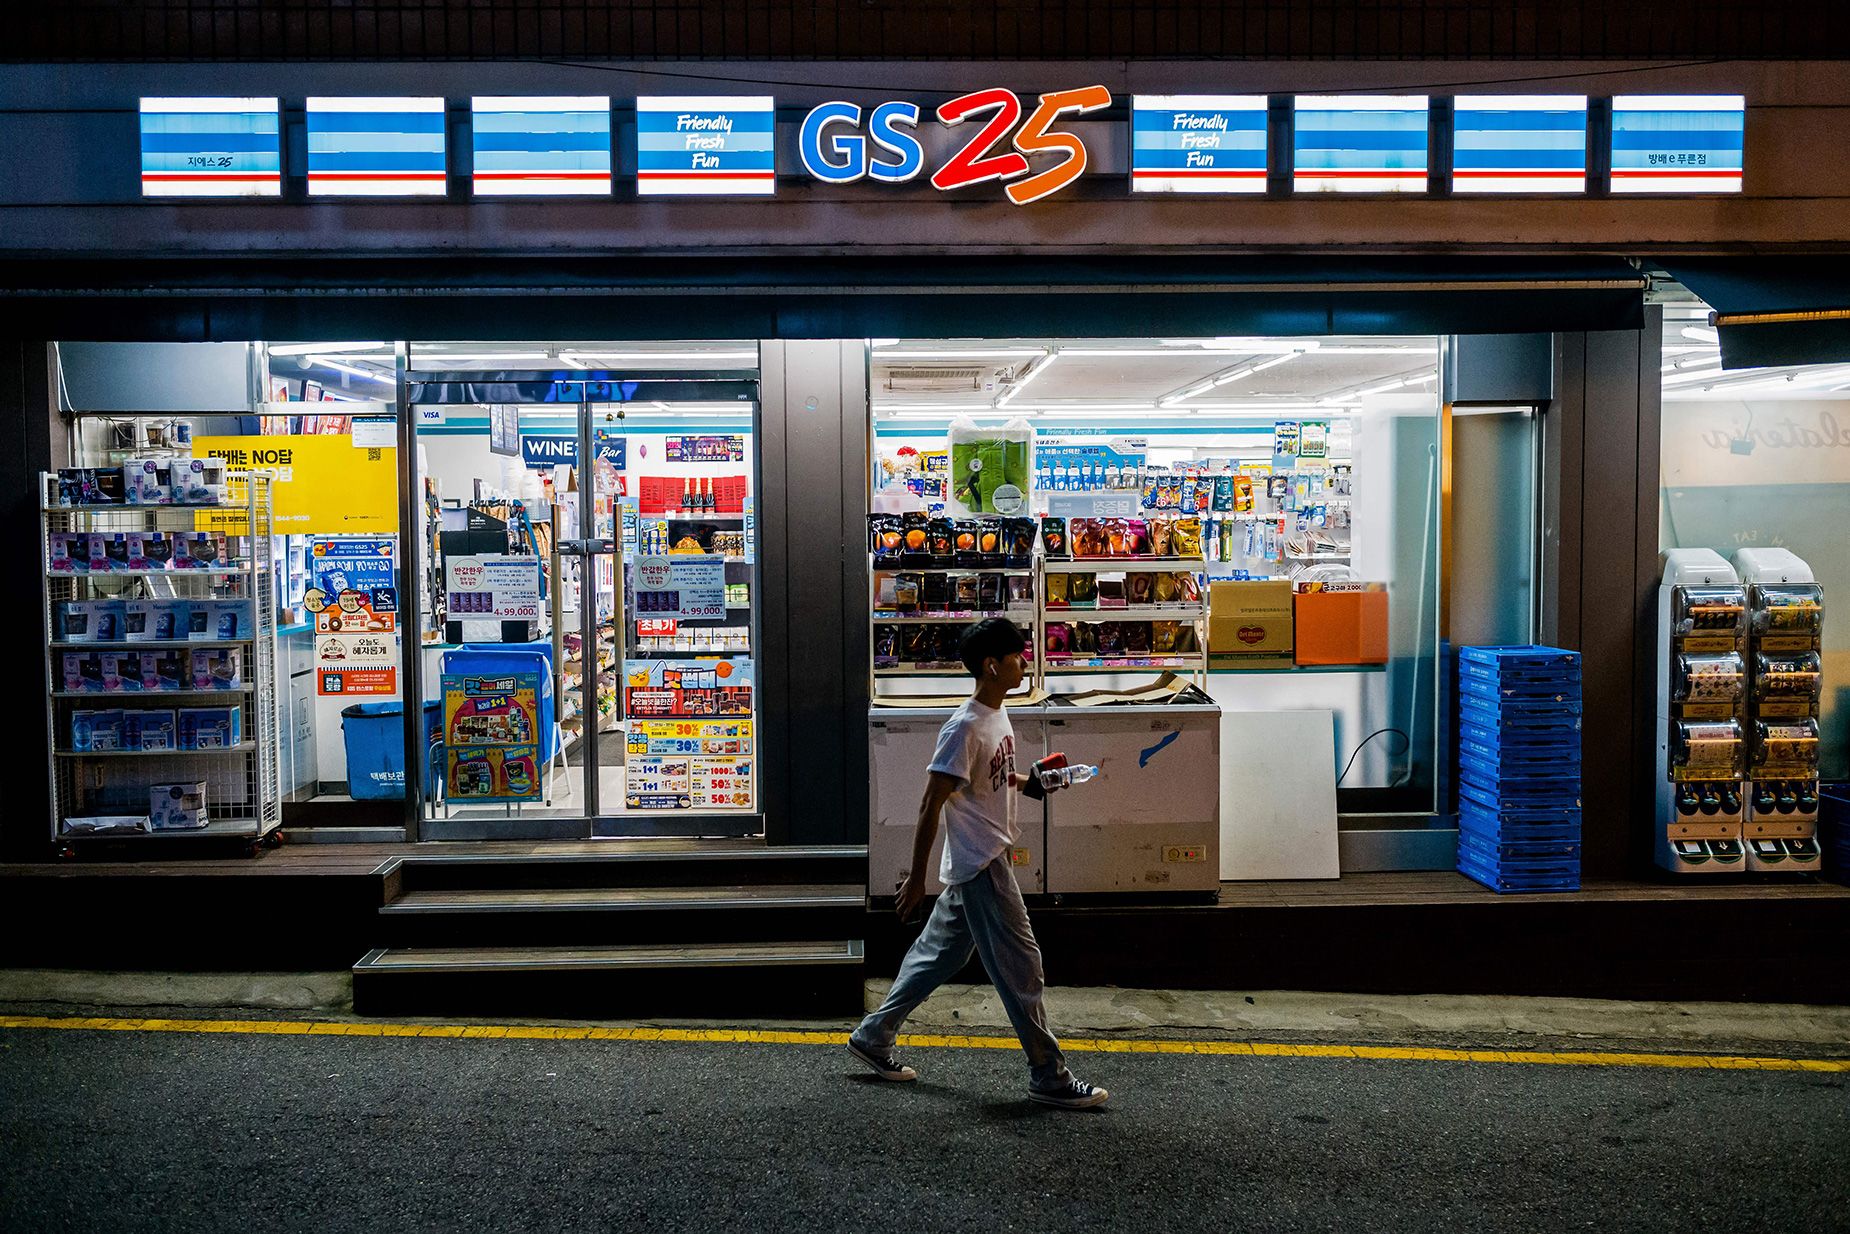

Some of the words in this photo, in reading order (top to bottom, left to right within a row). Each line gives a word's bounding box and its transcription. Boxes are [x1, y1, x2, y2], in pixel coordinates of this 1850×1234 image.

[677, 114, 733, 136] Friendly
[1173, 113, 1229, 135] Friendly
[686, 133, 725, 150] Fresh
[1182, 132, 1221, 149] Fresh
[188, 156, 216, 167] 지에스
[218, 156, 234, 168] 25
[692, 152, 720, 169] Fun
[1187, 151, 1214, 168] Fun
[1648, 153, 1667, 165] 방배
[1677, 153, 1706, 165] 푸른점
[423, 411, 440, 419] VISA
[252, 449, 293, 465] NO답
[599, 445, 622, 458] Bar
[641, 619, 674, 631] 초특가
[358, 638, 380, 646] 오늘도
[352, 646, 387, 655] 혜자롭게
[676, 740, 699, 752] 30%
[643, 765, 658, 774] 1+1
[643, 782, 658, 791] 1+1
[711, 779, 731, 789] 50%
[711, 794, 731, 804] 50%
